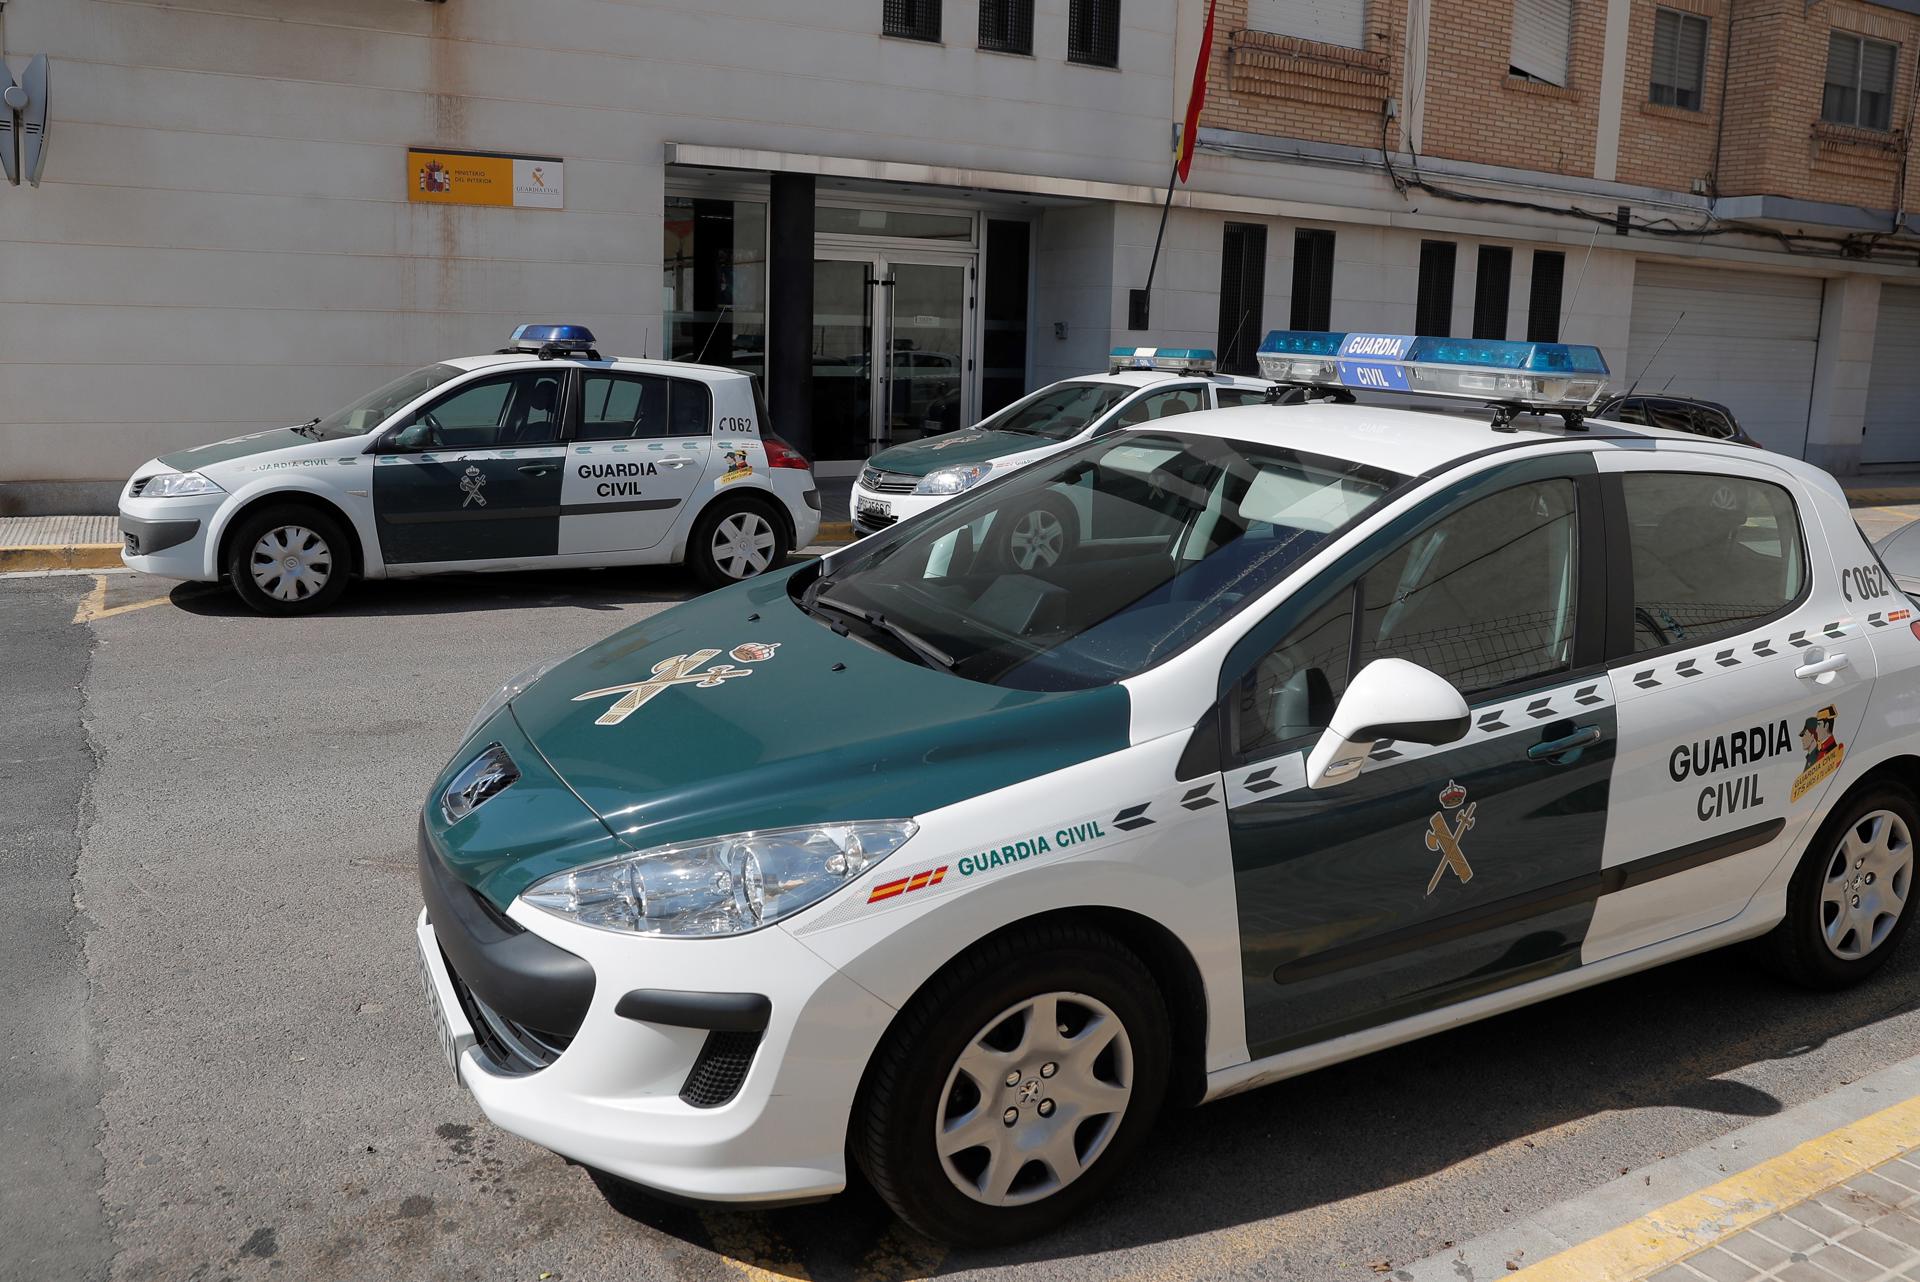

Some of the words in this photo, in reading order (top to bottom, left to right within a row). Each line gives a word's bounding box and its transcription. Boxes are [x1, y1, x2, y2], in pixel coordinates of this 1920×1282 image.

[1348, 336, 1402, 356] GUARDIA
[1356, 366, 1390, 387] CIVIL
[729, 417, 753, 433] 062
[302, 458, 328, 467] CIVIL
[577, 462, 658, 479] GUARDIA
[596, 481, 642, 497] CIVIL
[1852, 564, 1889, 600] 062
[1669, 719, 1792, 783] GUARDIA
[1794, 763, 1822, 788] GUARDIA
[1697, 773, 1764, 822] CIVIL
[957, 836, 1051, 876] GUARDIA
[1055, 821, 1105, 848] CIVIL
